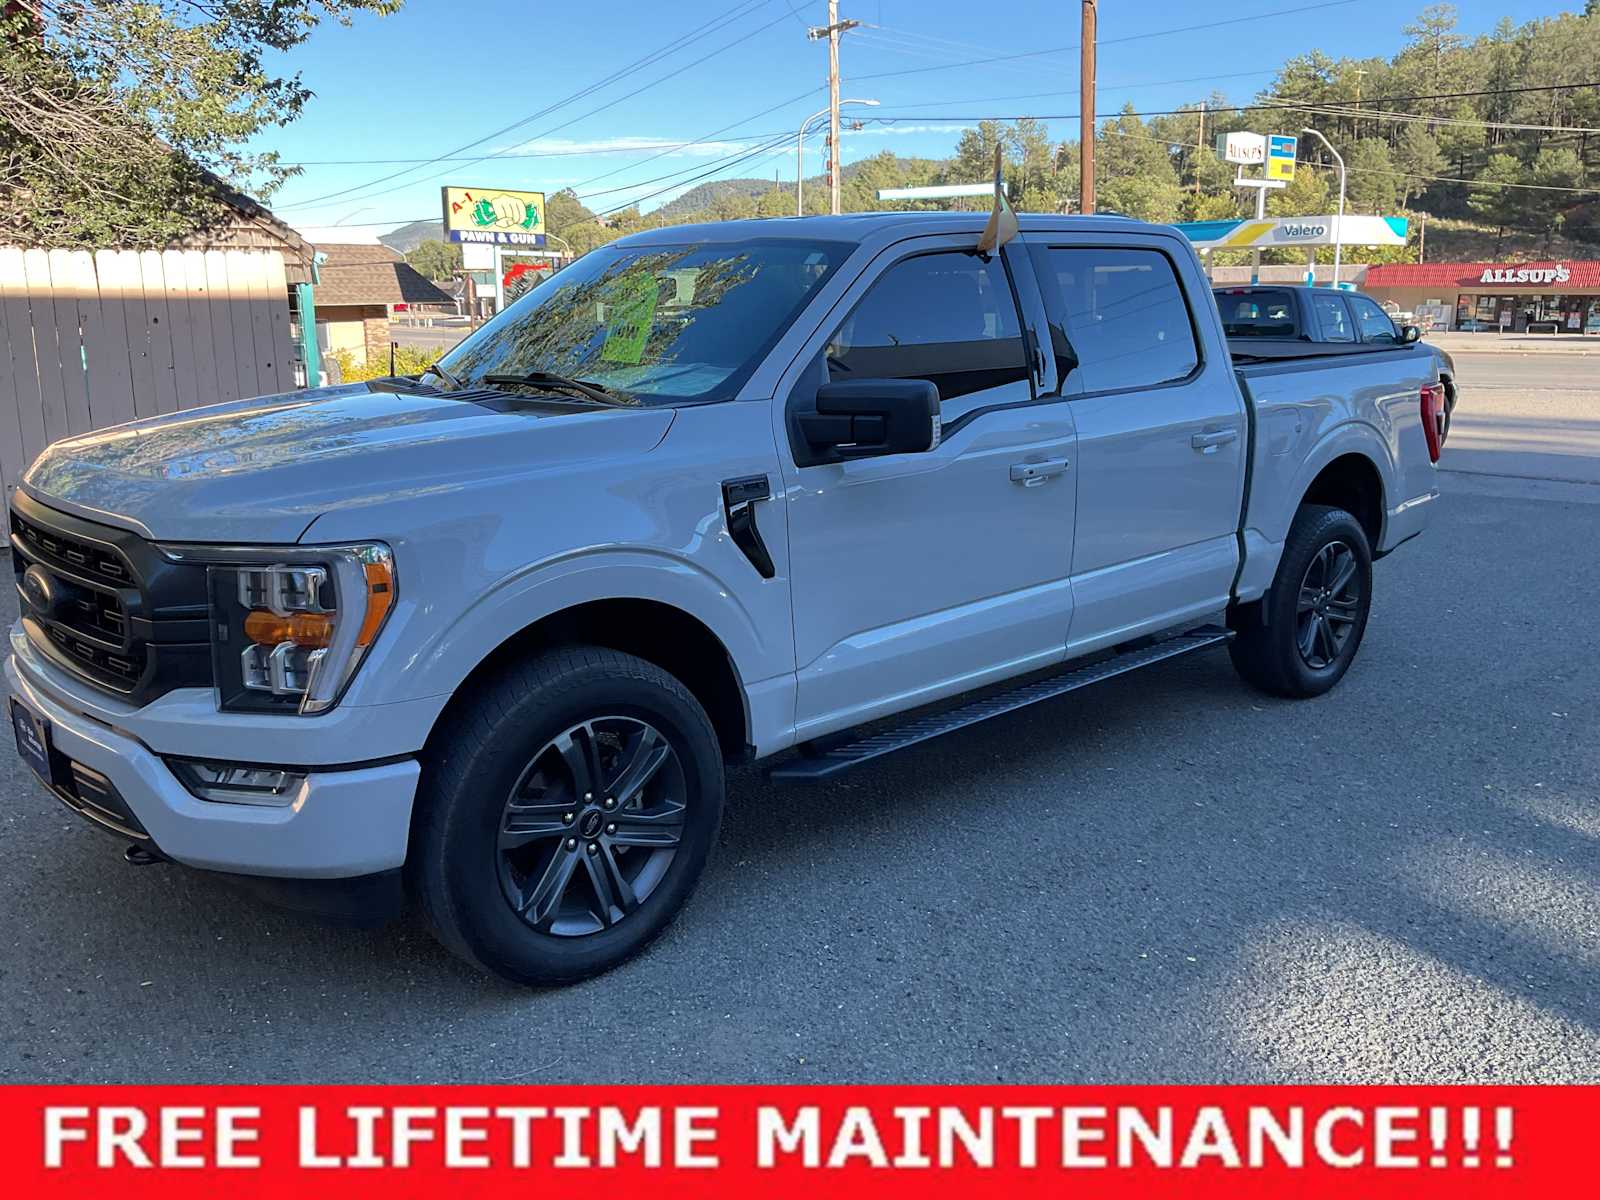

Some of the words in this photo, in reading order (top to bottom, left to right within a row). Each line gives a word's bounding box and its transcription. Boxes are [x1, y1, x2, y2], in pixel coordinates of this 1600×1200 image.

[1284, 224, 1325, 237] Valero
[460, 231, 495, 242] PAWN
[498, 232, 508, 243] &
[511, 234, 536, 245] GUN
[1480, 264, 1570, 283] ALLSUP'S
